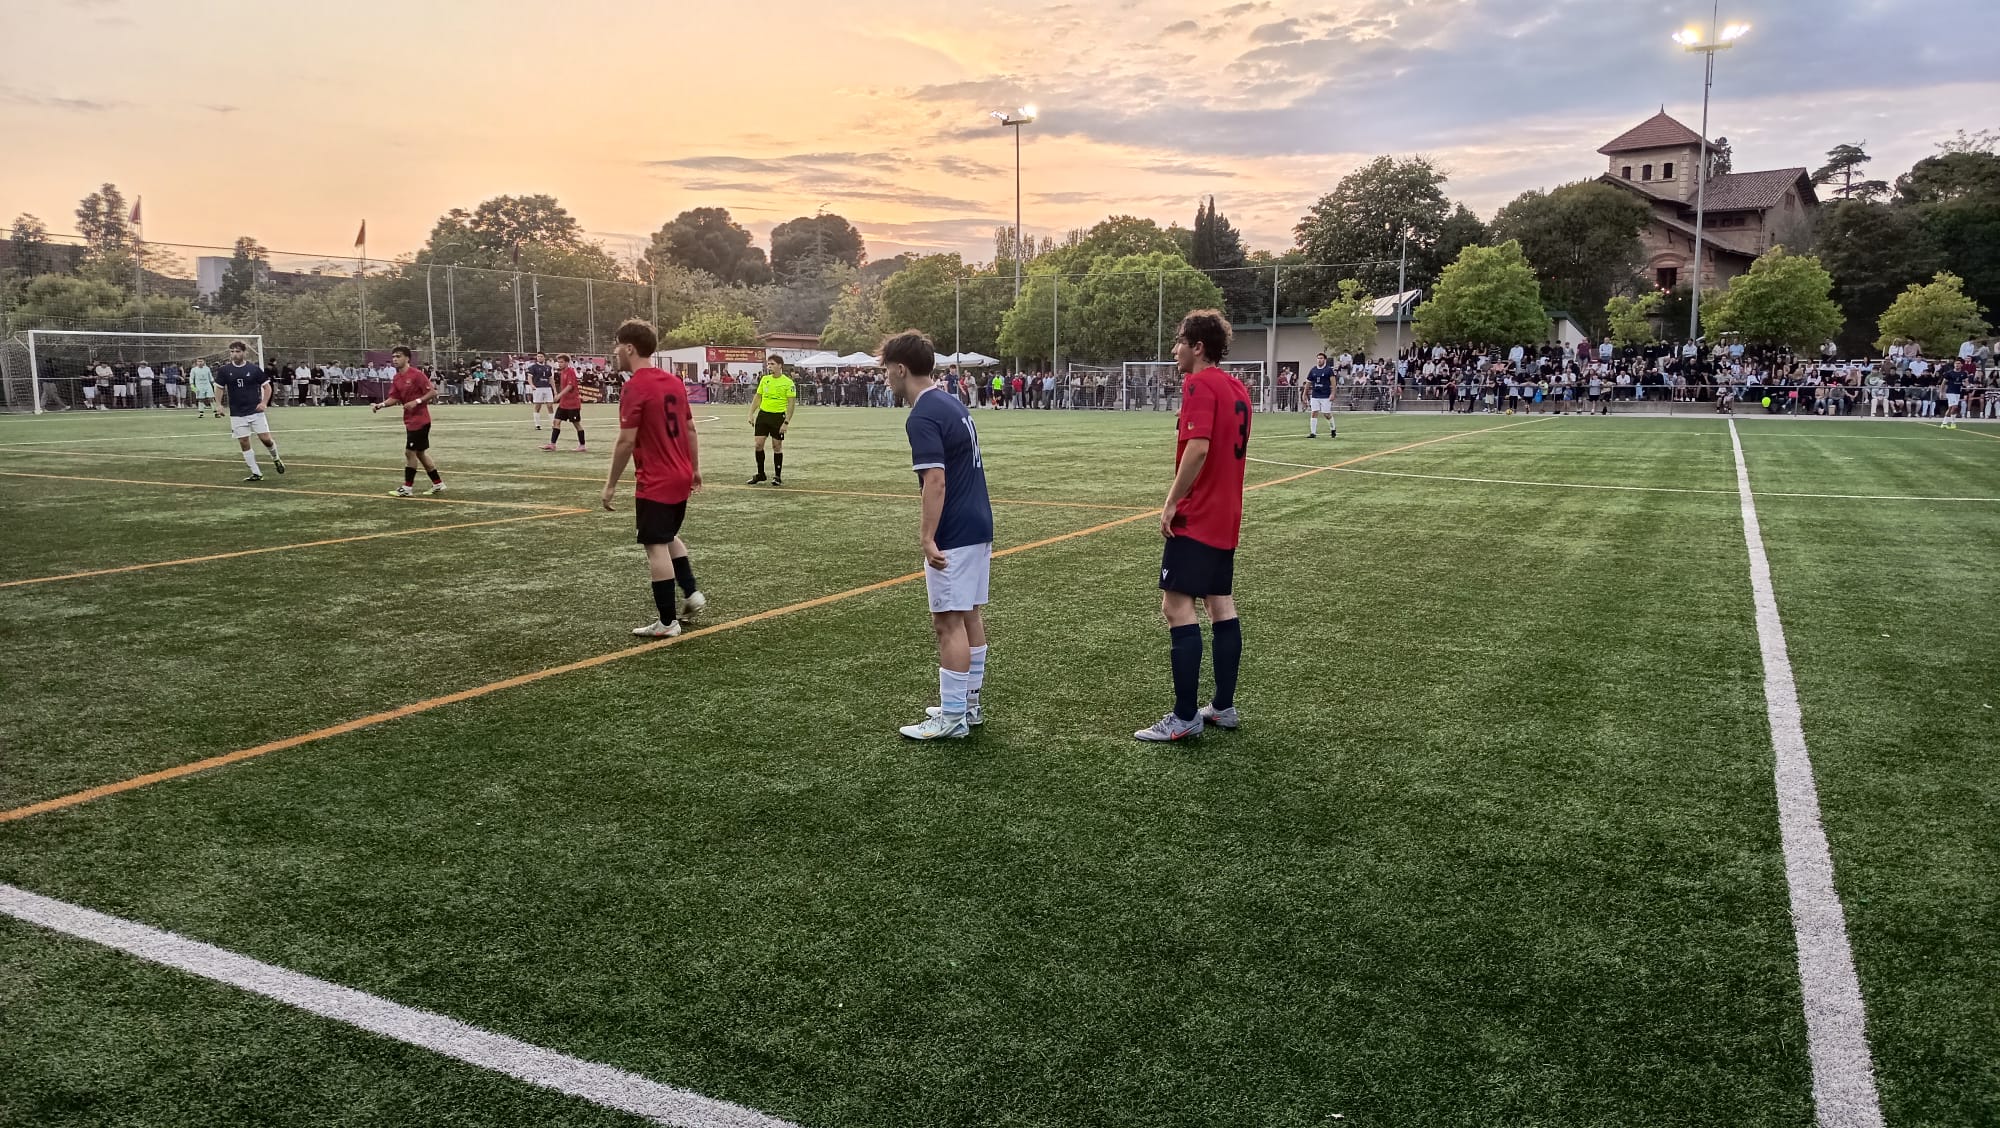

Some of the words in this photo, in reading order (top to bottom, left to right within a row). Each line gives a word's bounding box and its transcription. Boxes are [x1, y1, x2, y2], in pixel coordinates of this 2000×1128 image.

[236, 378, 244, 388] 51
[664, 394, 679, 437] 6
[1234, 401, 1248, 460] 3
